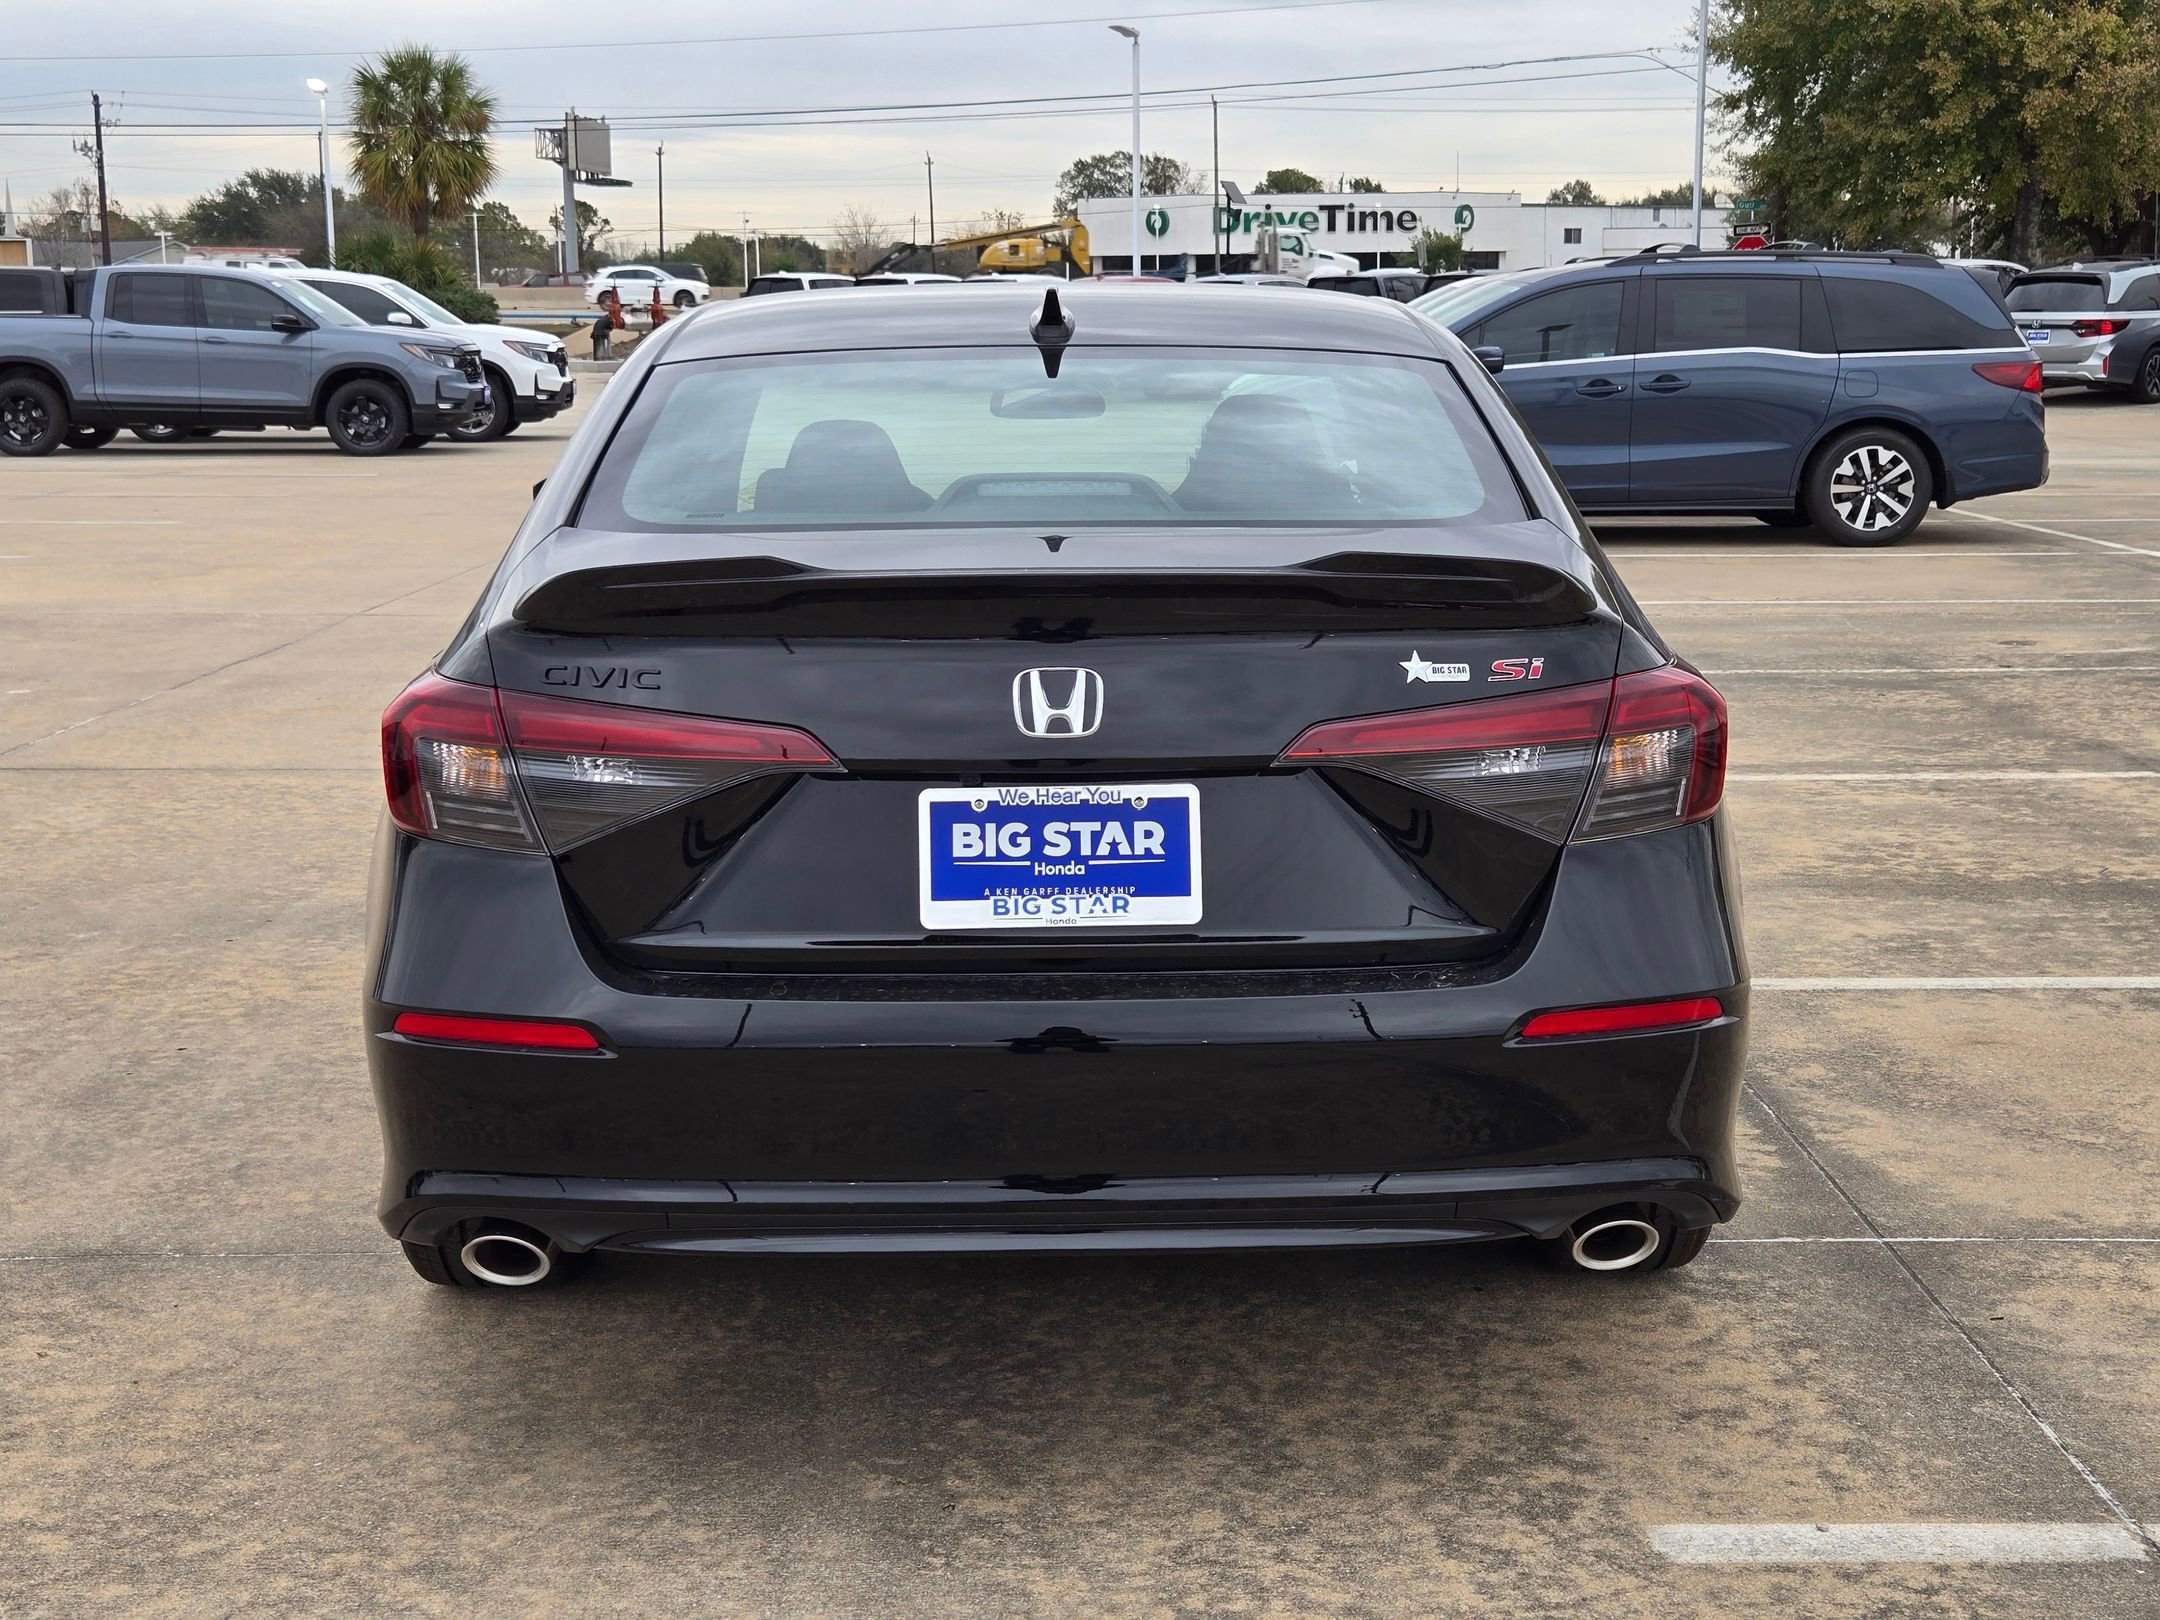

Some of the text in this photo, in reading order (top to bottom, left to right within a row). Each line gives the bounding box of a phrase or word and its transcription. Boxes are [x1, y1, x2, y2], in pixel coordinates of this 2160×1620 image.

[1214, 203, 1418, 234] DriveTime
[541, 665, 662, 690] CIVIC
[1432, 666, 1467, 675] BIG STAR
[1487, 657, 1545, 682] Si
[998, 788, 1122, 805] We Hear You
[952, 821, 1166, 858] BIG STAR
[1034, 861, 1086, 876] Honda
[984, 886, 1136, 896] A KEN GARFF DEALERSHIP
[992, 896, 1130, 916] BIG STAR
[1045, 917, 1078, 925] Honda
